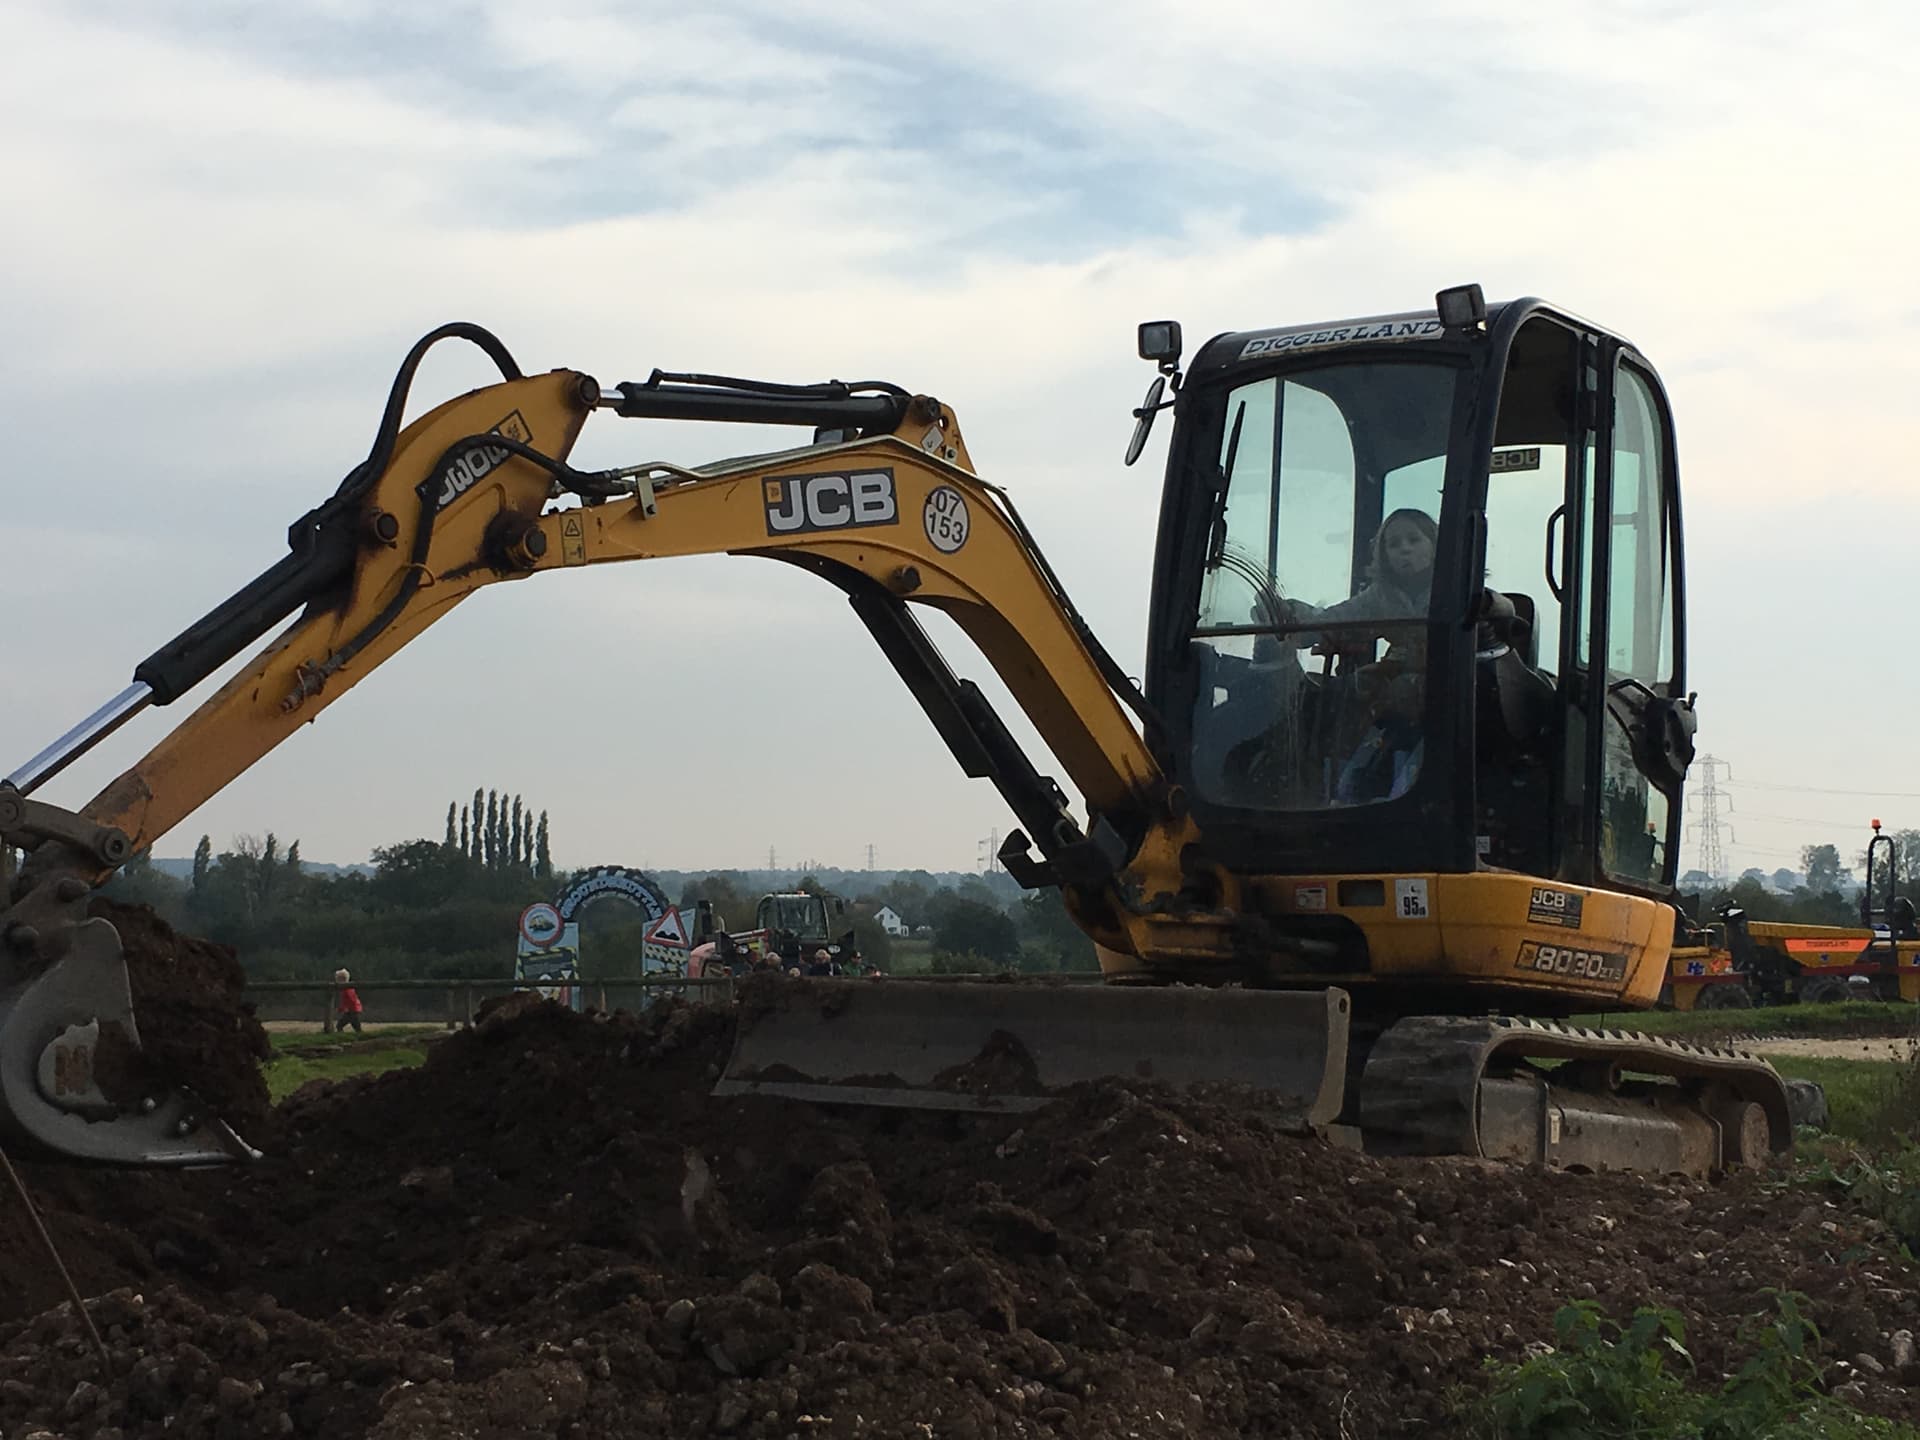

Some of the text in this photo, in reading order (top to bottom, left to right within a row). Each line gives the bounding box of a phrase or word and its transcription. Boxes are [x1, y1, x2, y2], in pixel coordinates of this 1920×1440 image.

[1245, 320, 1442, 354] DIGGERLAND
[769, 473, 896, 531] JCB
[935, 490, 962, 517] 07
[928, 511, 965, 544] 153
[1532, 889, 1566, 908] JCB
[1535, 945, 1604, 978] 8030
